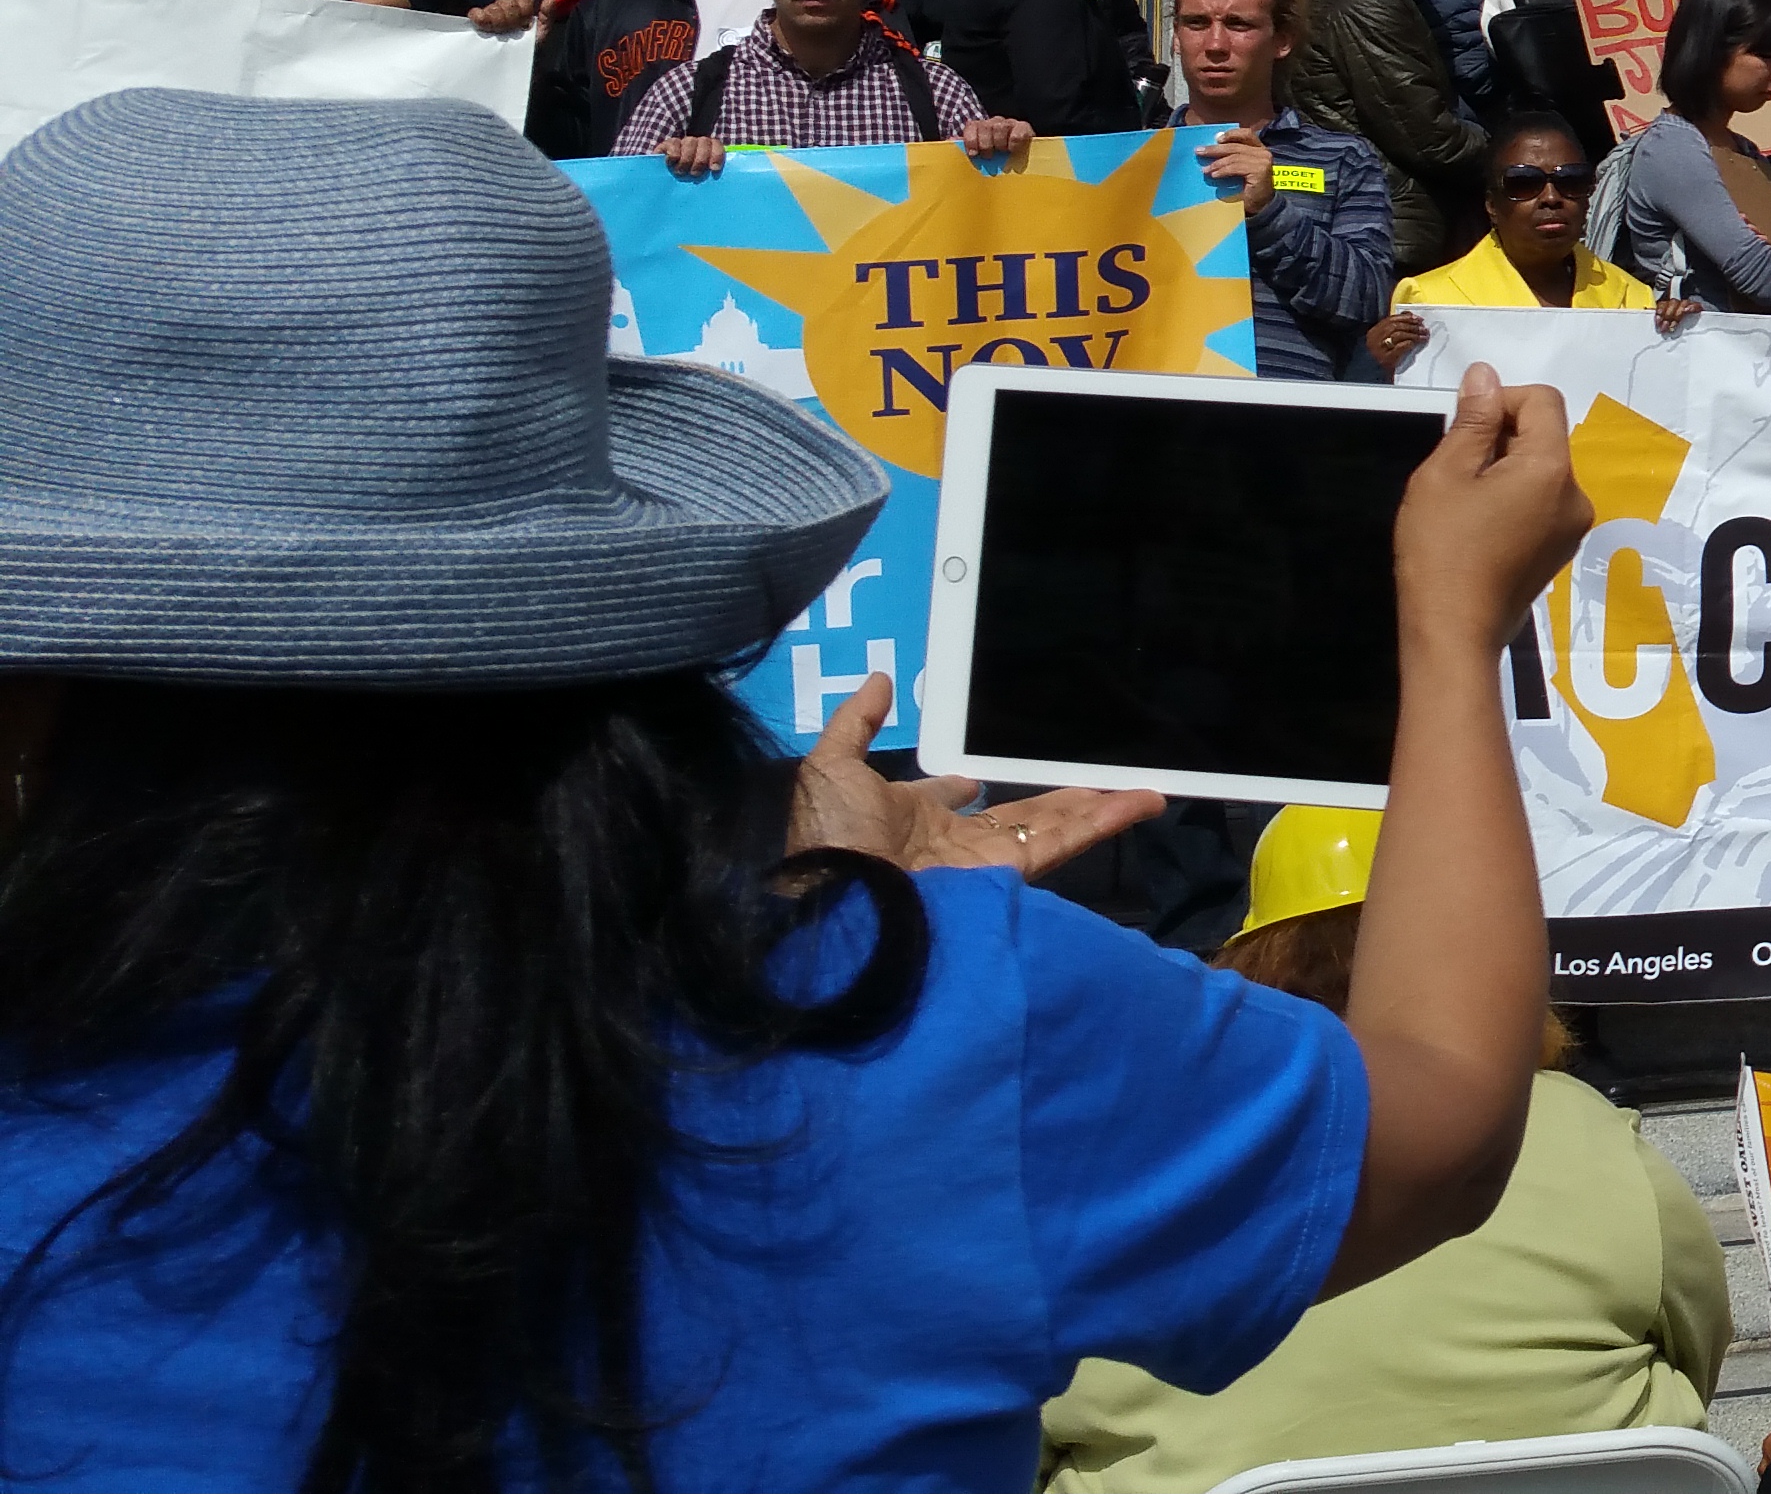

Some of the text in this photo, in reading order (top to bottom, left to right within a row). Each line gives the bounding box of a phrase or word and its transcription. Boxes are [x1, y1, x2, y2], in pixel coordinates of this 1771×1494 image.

[1272, 170, 1316, 178] UDGET
[854, 242, 1152, 331] THIS
[1554, 953, 1601, 977] Los
[1603, 947, 1713, 980] Angeles
